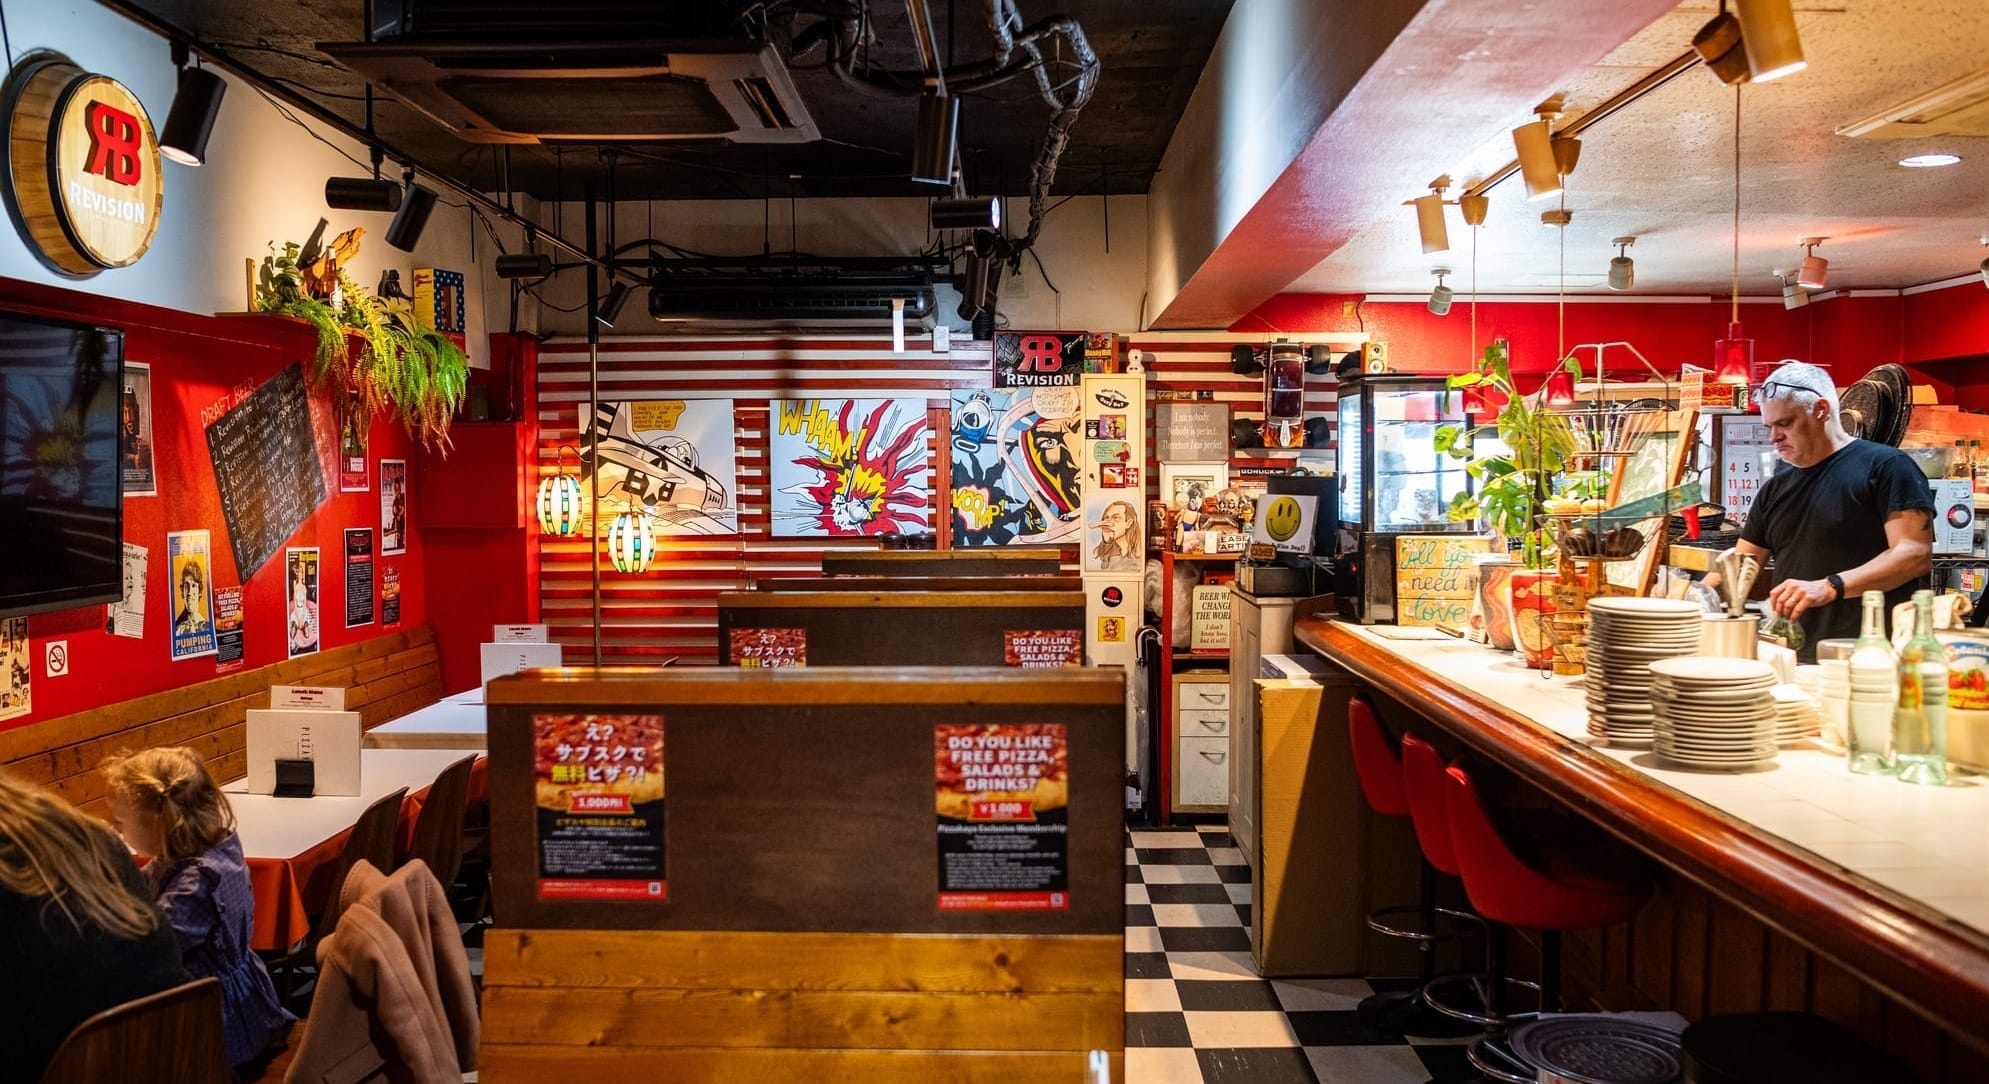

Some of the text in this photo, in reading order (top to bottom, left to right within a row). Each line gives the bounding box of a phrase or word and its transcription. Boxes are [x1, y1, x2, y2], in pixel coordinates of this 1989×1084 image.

[70, 181, 145, 225] REVISION
[1006, 373, 1075, 386] REVISION
[201, 395, 231, 429] DRAFT
[779, 399, 868, 463] WHAAM!
[1729, 462, 1751, 473] 4 5
[1728, 480, 1738, 489] 11
[1741, 480, 1752, 489] 12
[1728, 496, 1752, 506] 18 19
[1400, 541, 1438, 570] All
[1412, 566, 1461, 592] need
[1200, 592, 1219, 601] BEER
[1196, 611, 1211, 620] THE
[1414, 593, 1466, 624] love
[176, 634, 212, 649] PUMPING
[1051, 637, 1073, 645] LIKE
[176, 643, 213, 656] CALIFORNIA
[1020, 653, 1057, 661] SALADS
[587, 722, 614, 741] え?
[948, 736, 1053, 750] DO YOU LIKE
[555, 744, 646, 762] サブスクで
[951, 749, 1055, 765] FREE PIZZA,
[961, 763, 1041, 778] SALADS &
[965, 778, 1038, 792] DRINKS?
